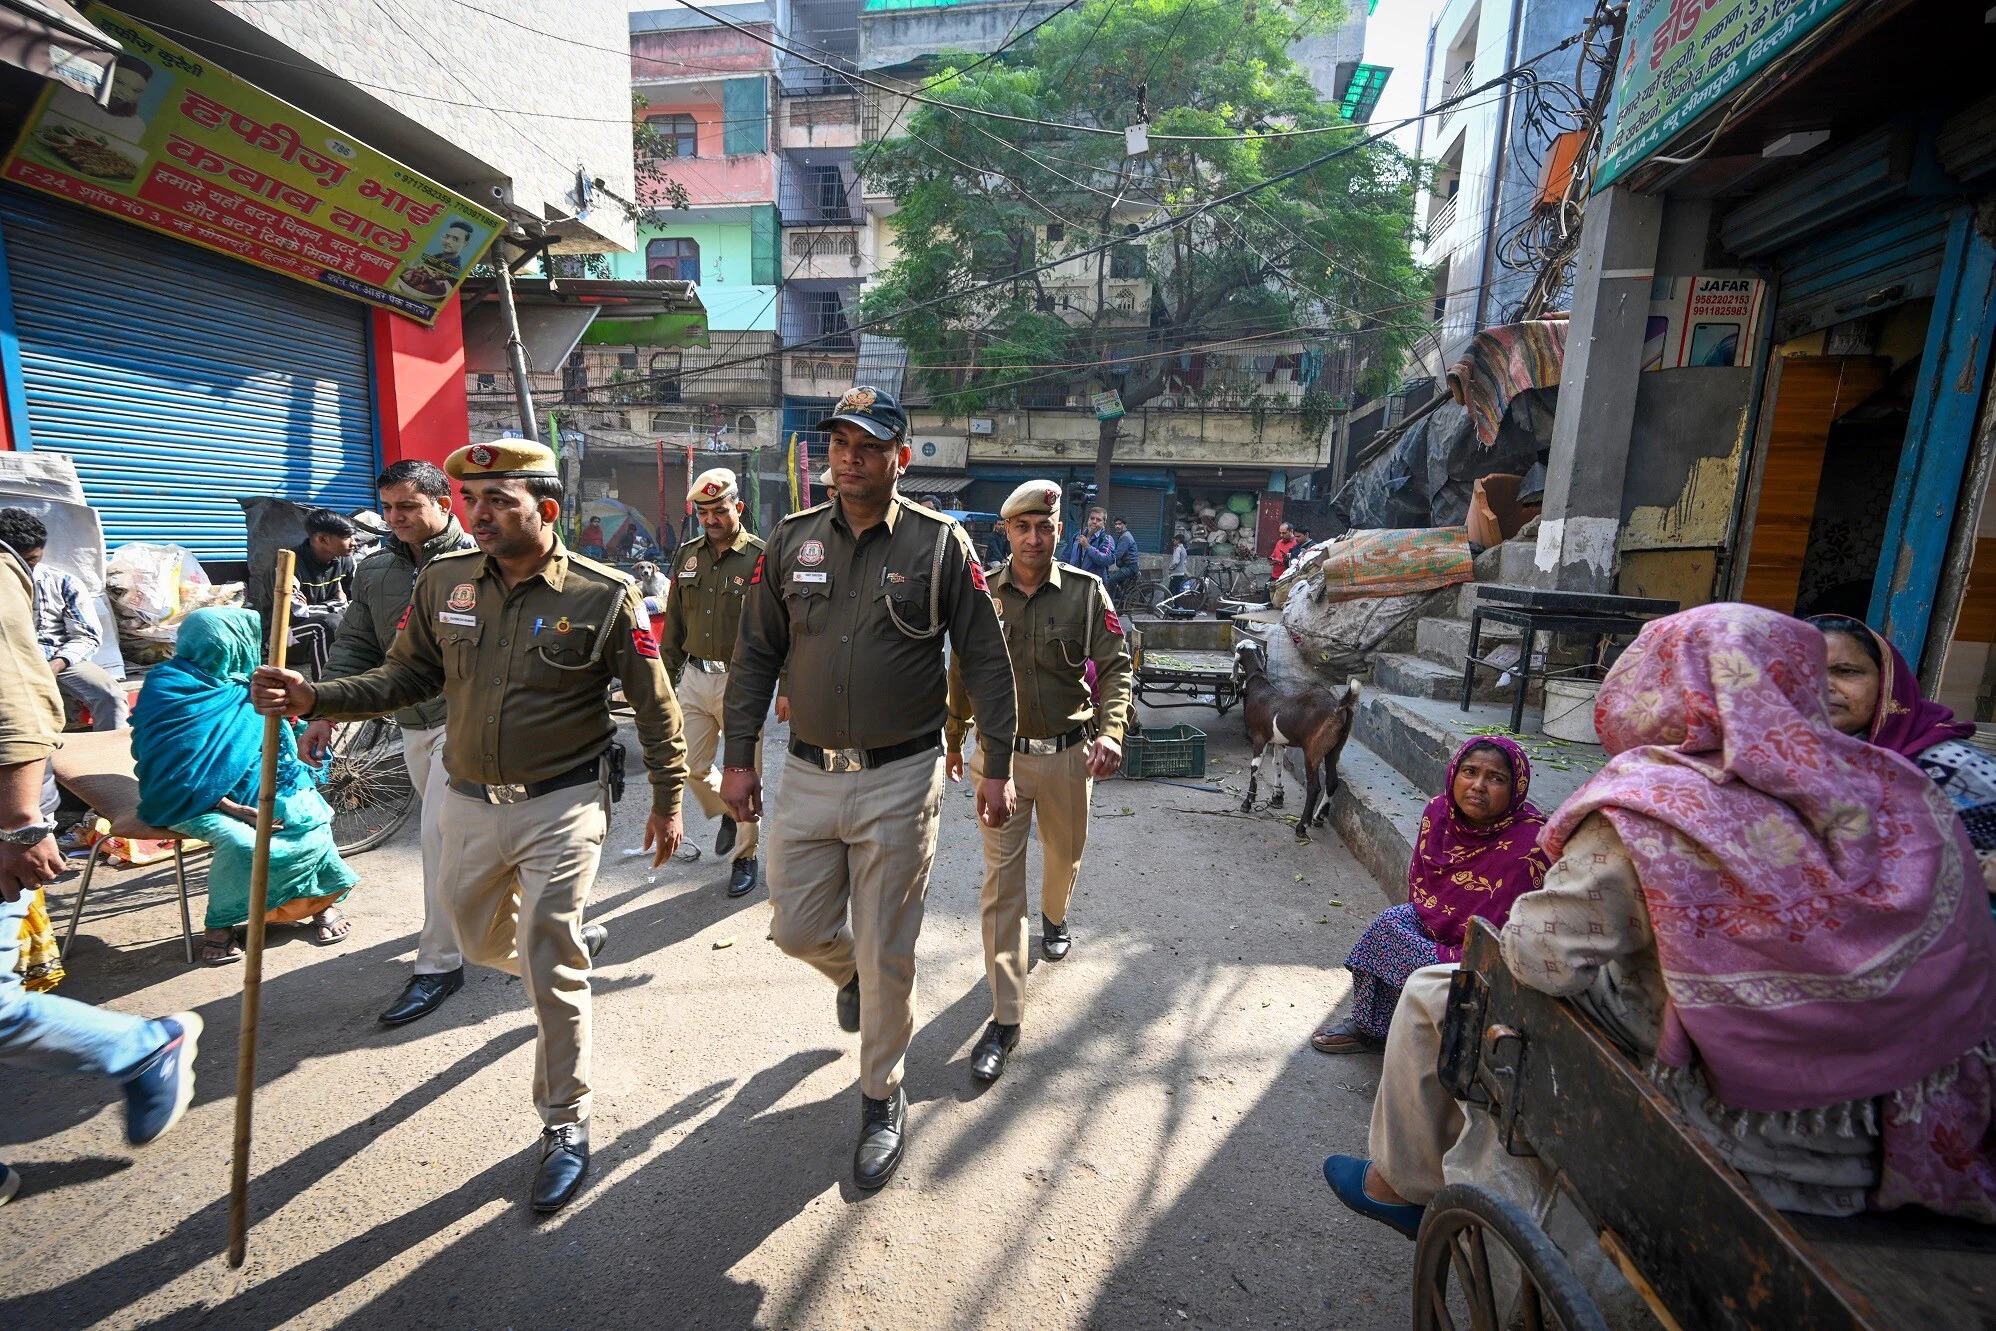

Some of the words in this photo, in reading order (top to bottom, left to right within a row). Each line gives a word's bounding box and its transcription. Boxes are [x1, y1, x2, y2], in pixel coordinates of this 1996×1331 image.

[1603, 129, 1624, 159] आदि
[1625, 99, 1662, 141] खरीदने,
[1665, 70, 1693, 106] बेचने
[1694, 64, 1706, 83] व
[1707, 23, 1749, 73] किराये
[1751, 5, 1769, 35] के
[1617, 91, 1641, 126] हमारे
[1701, 2, 1744, 50] मकान,
[1662, 110, 1680, 131] न्यू
[1682, 60, 1739, 116] सीमापुरी,
[177, 87, 352, 188] हफीज़
[358, 178, 446, 227] भाई
[331, 141, 351, 156] 786
[18, 165, 70, 192] F-24,
[79, 184, 118, 206] शॉप
[155, 169, 205, 196] हमारे
[244, 204, 278, 224] बटर
[280, 216, 323, 246] चिकन,
[329, 238, 359, 256] बटर
[360, 251, 395, 271] कबाब
[164, 132, 326, 216] कबाब
[329, 205, 418, 254] वाले
[182, 200, 219, 221] और
[221, 215, 257, 236] बटर
[301, 242, 343, 267] मिलते
[1693, 306, 1747, 315] 9911825983
[1695, 295, 1750, 304] 9582202153
[1700, 281, 1749, 291] JAFAR
